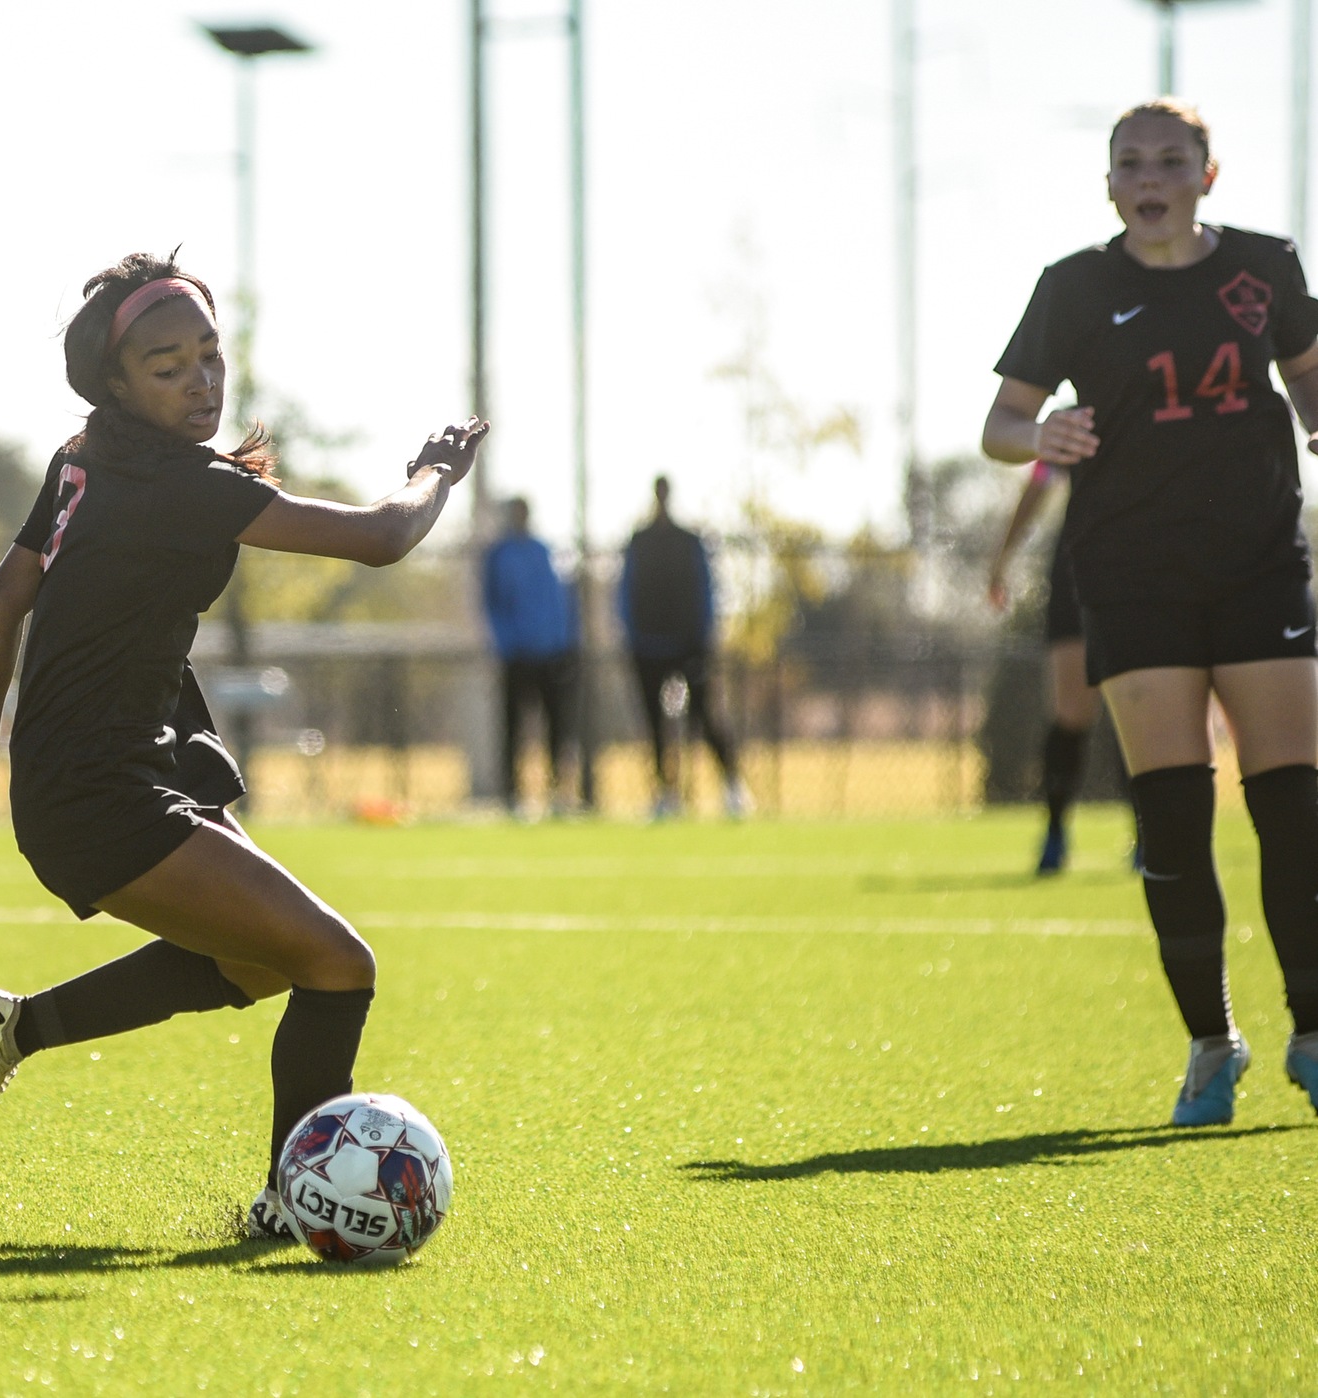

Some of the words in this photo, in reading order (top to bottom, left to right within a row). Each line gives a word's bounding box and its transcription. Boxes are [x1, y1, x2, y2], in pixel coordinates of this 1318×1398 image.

[1147, 342, 1250, 422] 14
[40, 463, 87, 573] 3
[295, 1183, 388, 1238] SELECT
